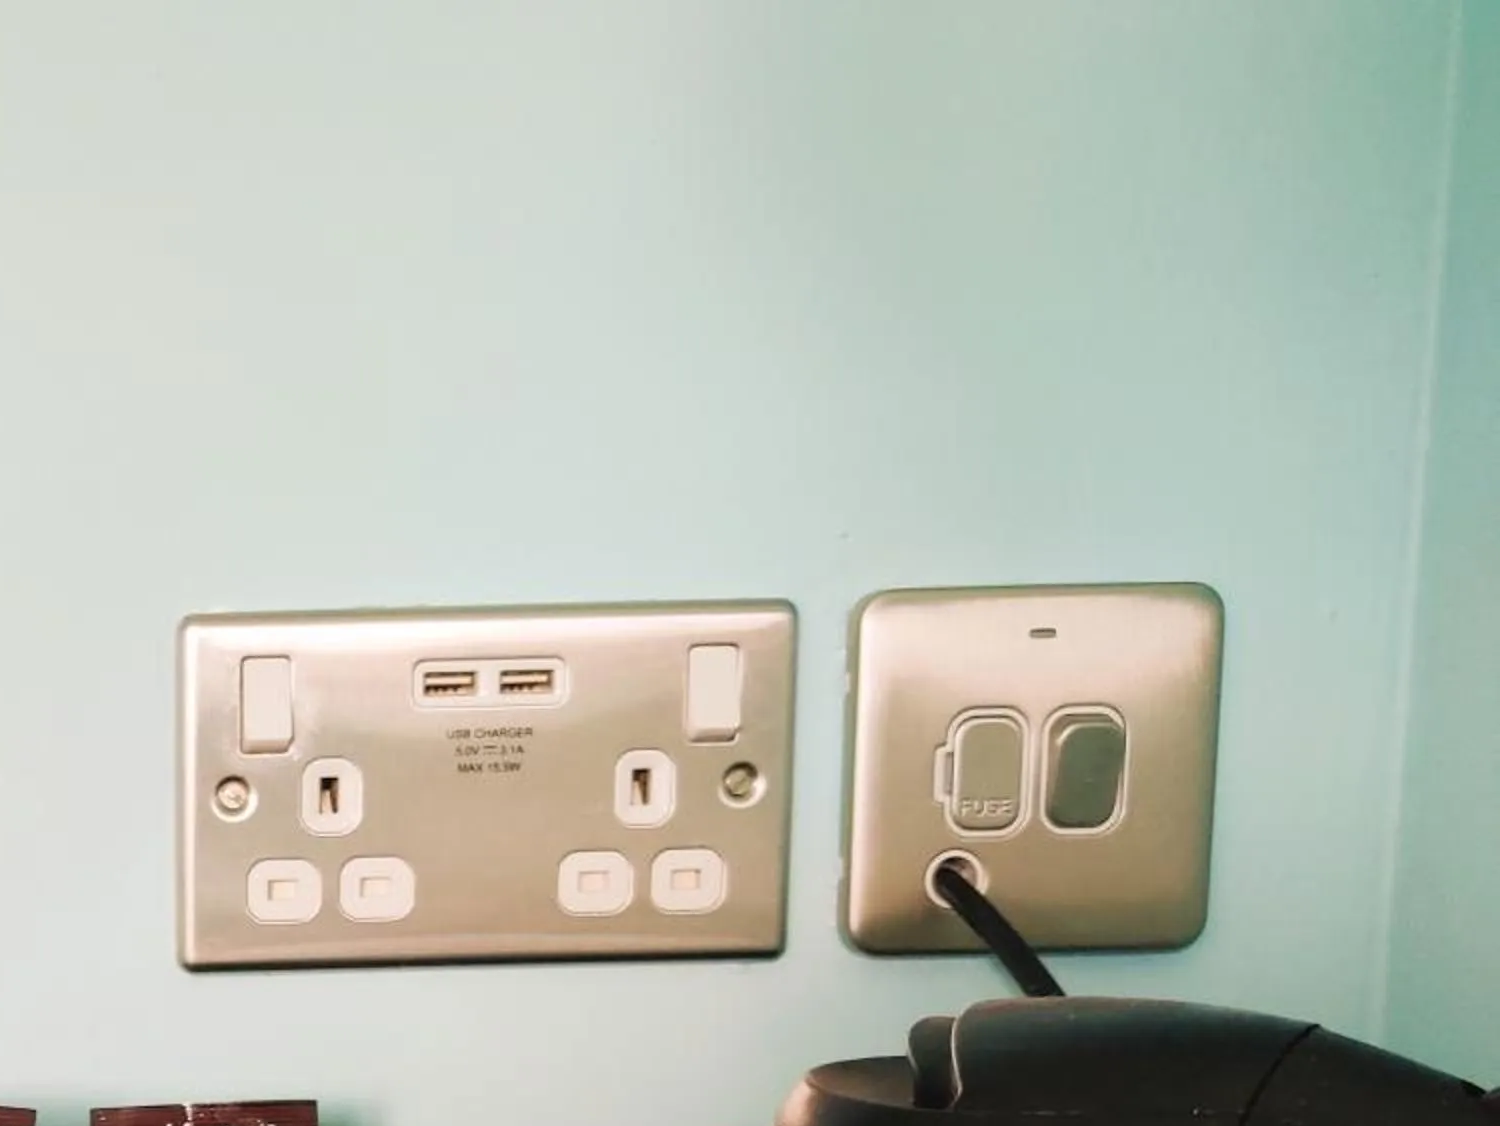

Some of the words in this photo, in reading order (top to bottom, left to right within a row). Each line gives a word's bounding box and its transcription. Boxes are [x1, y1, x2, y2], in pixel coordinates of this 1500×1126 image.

[446, 728, 470, 740] USB
[473, 726, 533, 739] CHARGER
[960, 798, 1013, 817] FUSE
